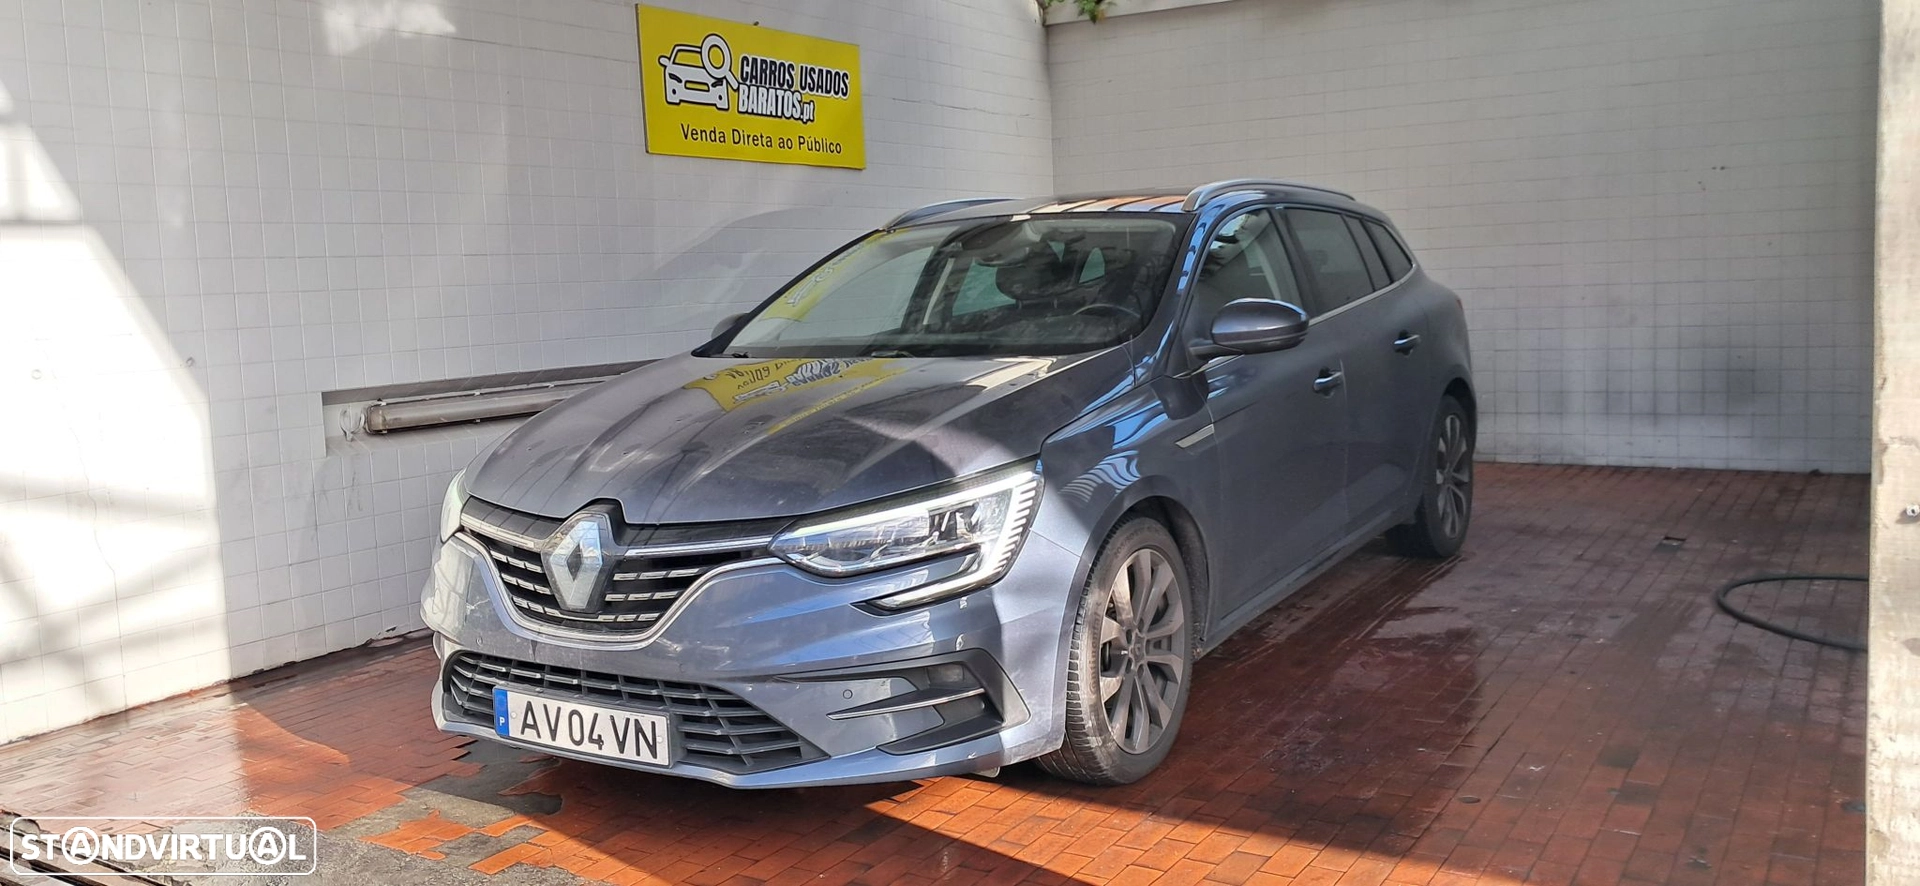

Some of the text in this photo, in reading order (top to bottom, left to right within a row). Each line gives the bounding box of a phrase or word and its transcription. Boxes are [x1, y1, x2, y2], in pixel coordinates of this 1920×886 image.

[740, 55, 849, 97] CARROS USADOS
[738, 85, 815, 123] BARATOS.pt
[681, 123, 842, 154] Venda Direta ao Público
[499, 716, 505, 727] P
[520, 700, 658, 759] AV 04 VN
